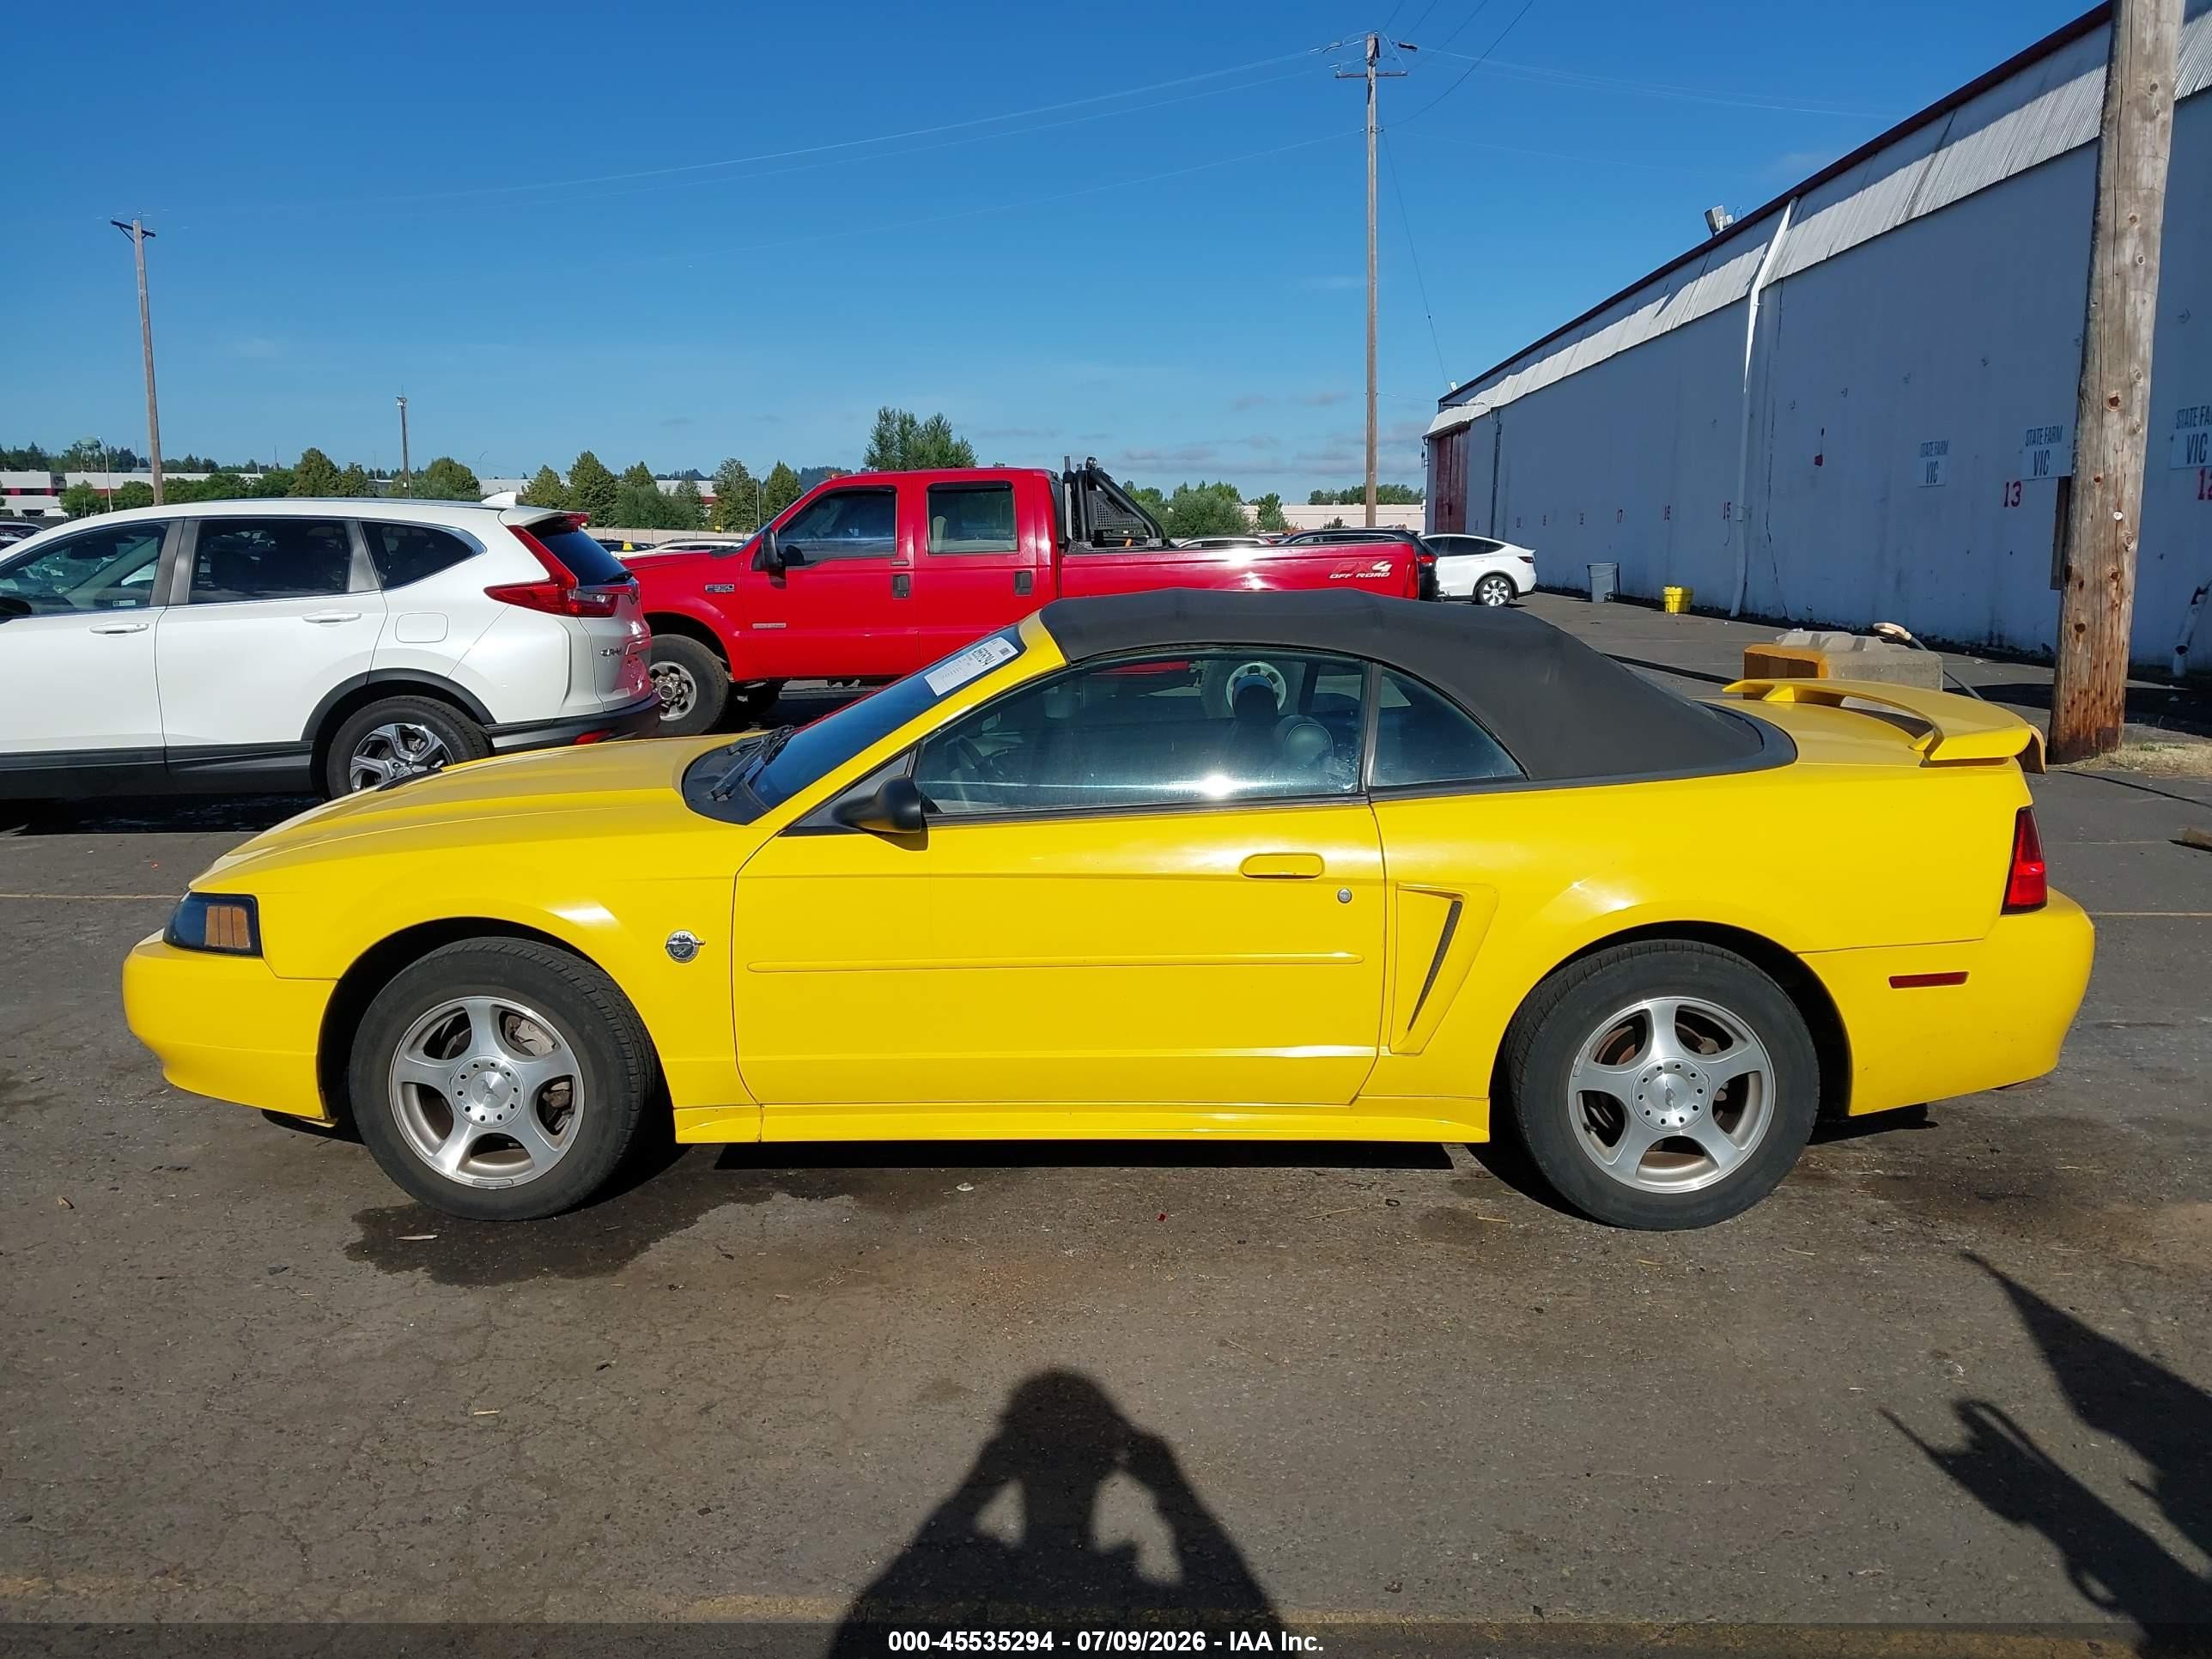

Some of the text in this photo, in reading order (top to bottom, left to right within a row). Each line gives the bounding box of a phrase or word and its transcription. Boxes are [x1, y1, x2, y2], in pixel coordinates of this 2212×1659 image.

[2176, 406, 2198, 429] STATE
[2026, 425, 2063, 447] STATE FARM
[2186, 433, 2208, 464] VIC
[1926, 460, 1938, 483] VIC
[2033, 449, 2051, 476] VIC
[2003, 481, 2021, 507] 13
[1332, 560, 1393, 573] FX4
